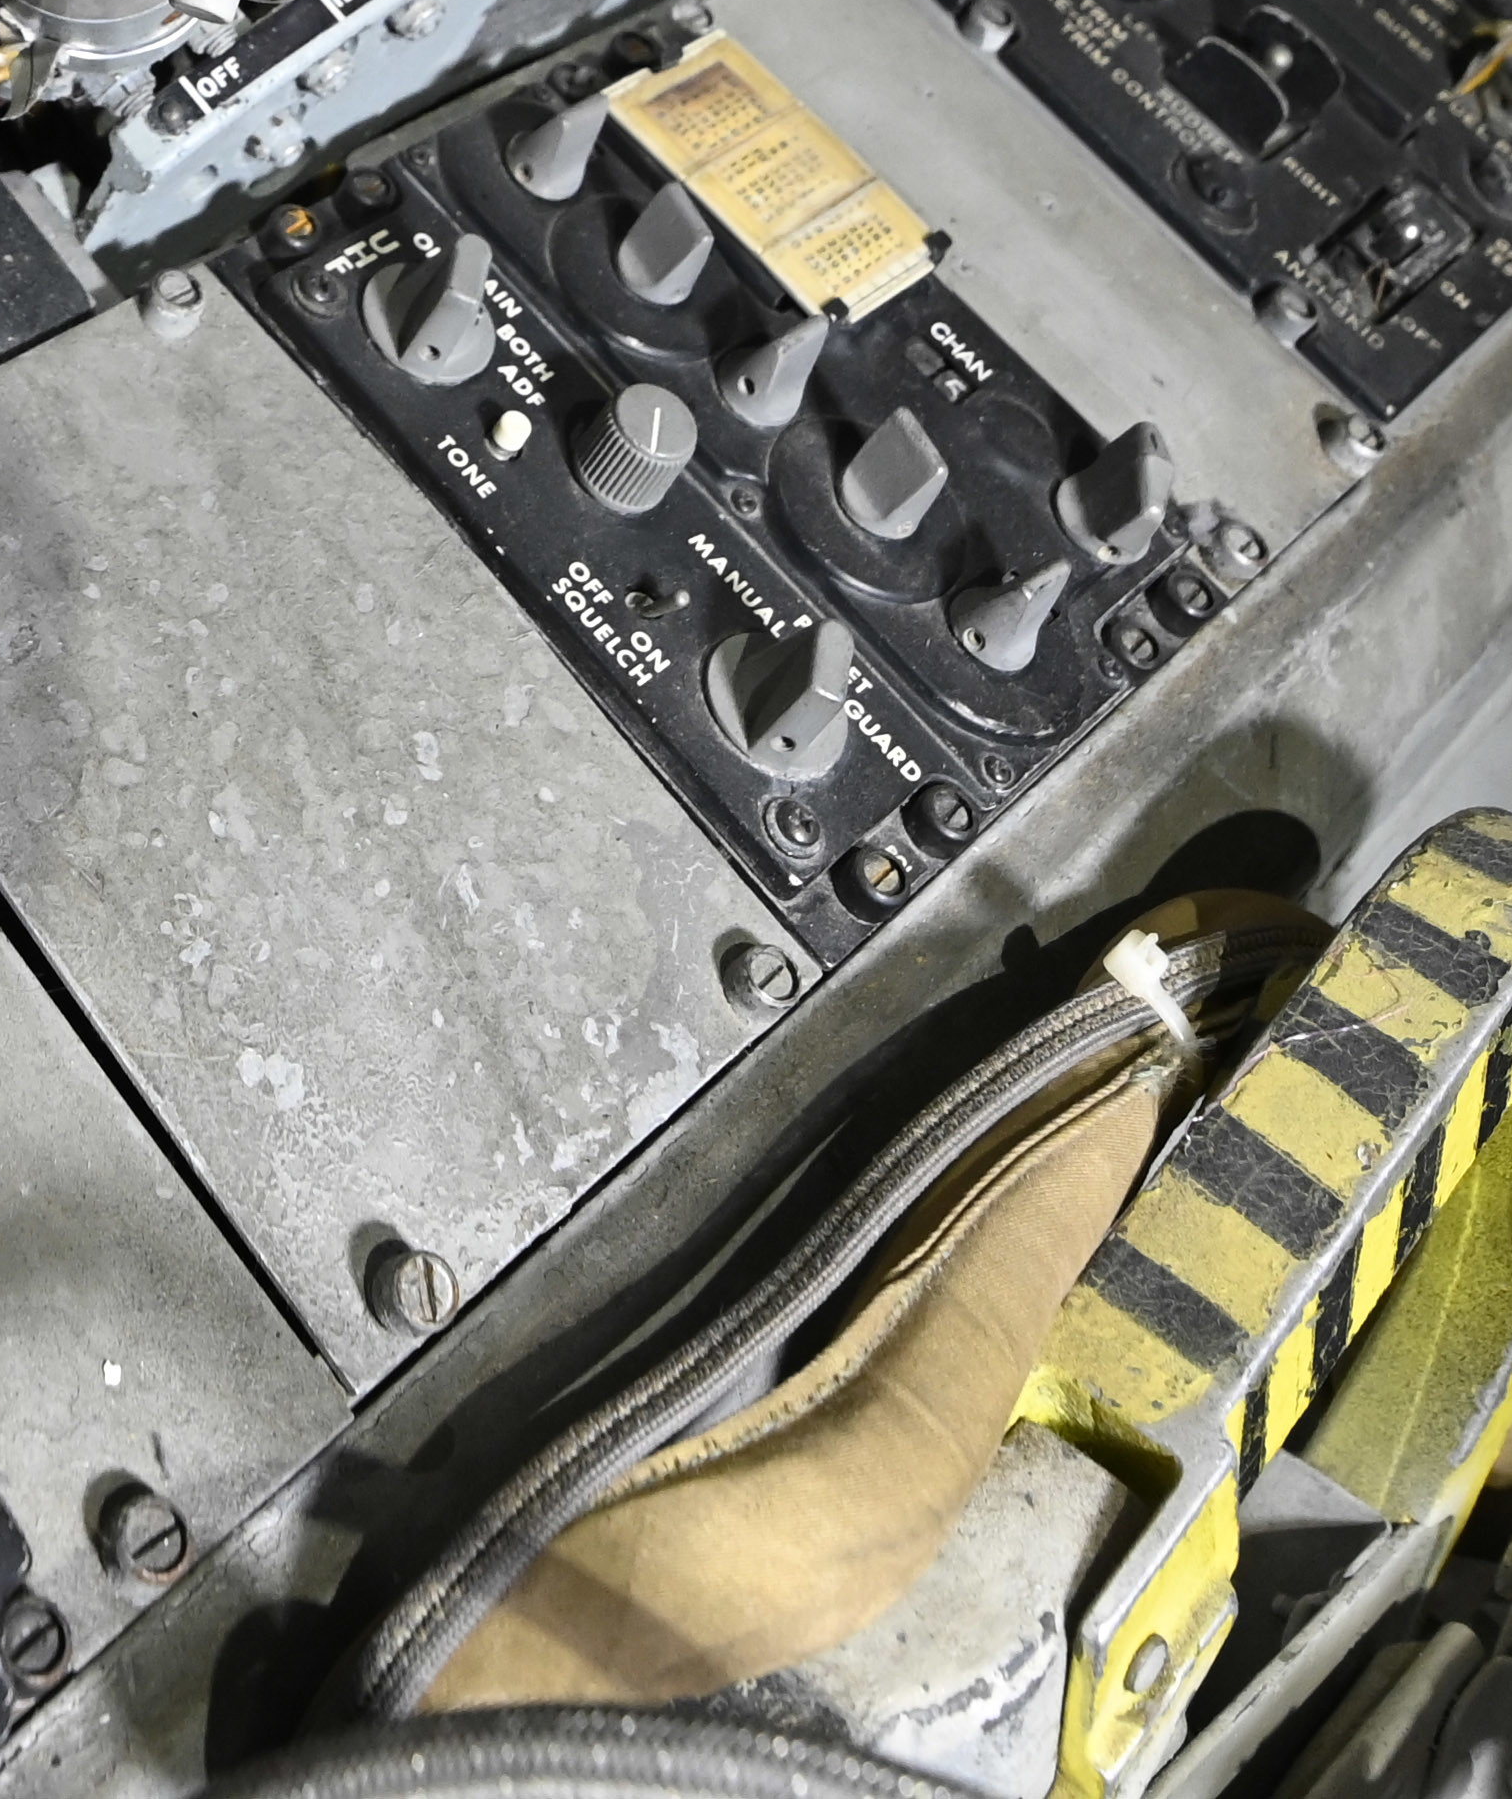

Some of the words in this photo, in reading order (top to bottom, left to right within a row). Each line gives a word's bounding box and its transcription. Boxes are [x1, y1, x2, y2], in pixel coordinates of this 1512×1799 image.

[196, 56, 243, 98] OFF
[1280, 153, 1342, 208] RIGHT
[1439, 280, 1471, 310] ON
[496, 322, 556, 384] BOTH
[928, 320, 993, 383] CHAN
[1399, 315, 1443, 350] OFF
[497, 363, 547, 411] ADF
[436, 434, 498, 500] TONE
[567, 559, 615, 607] OFF
[687, 532, 784, 639] MANUAL
[552, 578, 652, 688] SQUELCH
[630, 630, 671, 676] ON
[843, 697, 922, 784] GUARD
